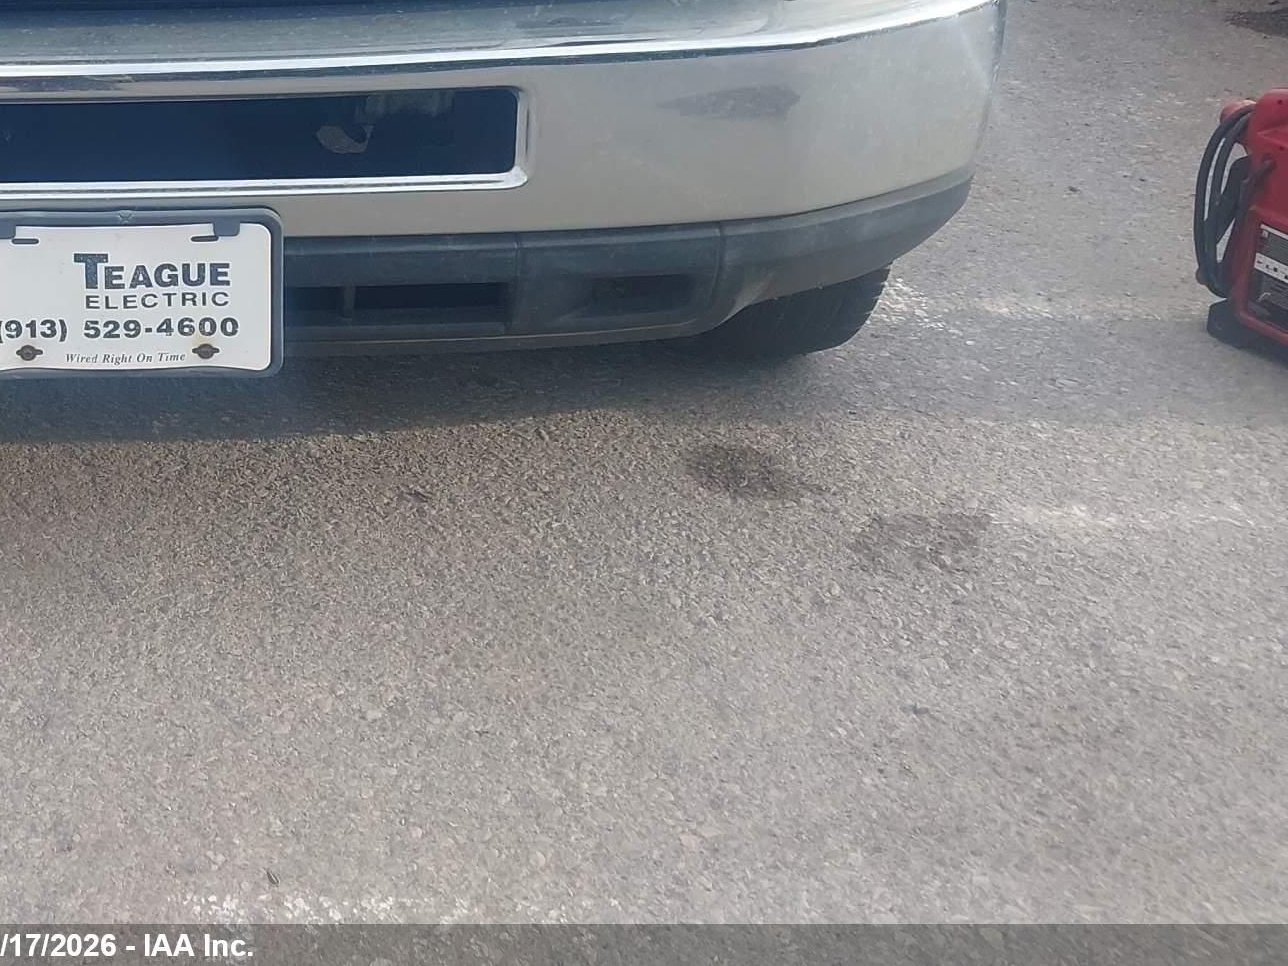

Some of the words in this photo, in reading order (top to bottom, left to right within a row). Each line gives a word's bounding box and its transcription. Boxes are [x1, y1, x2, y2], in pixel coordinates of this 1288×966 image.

[74, 253, 230, 289] TEAGUE
[86, 292, 228, 309] ELECTRIC
[84, 317, 238, 338] 529-4600
[65, 353, 98, 364] Wired
[102, 353, 132, 366] Right
[136, 352, 153, 363] On
[157, 351, 186, 363] Time
